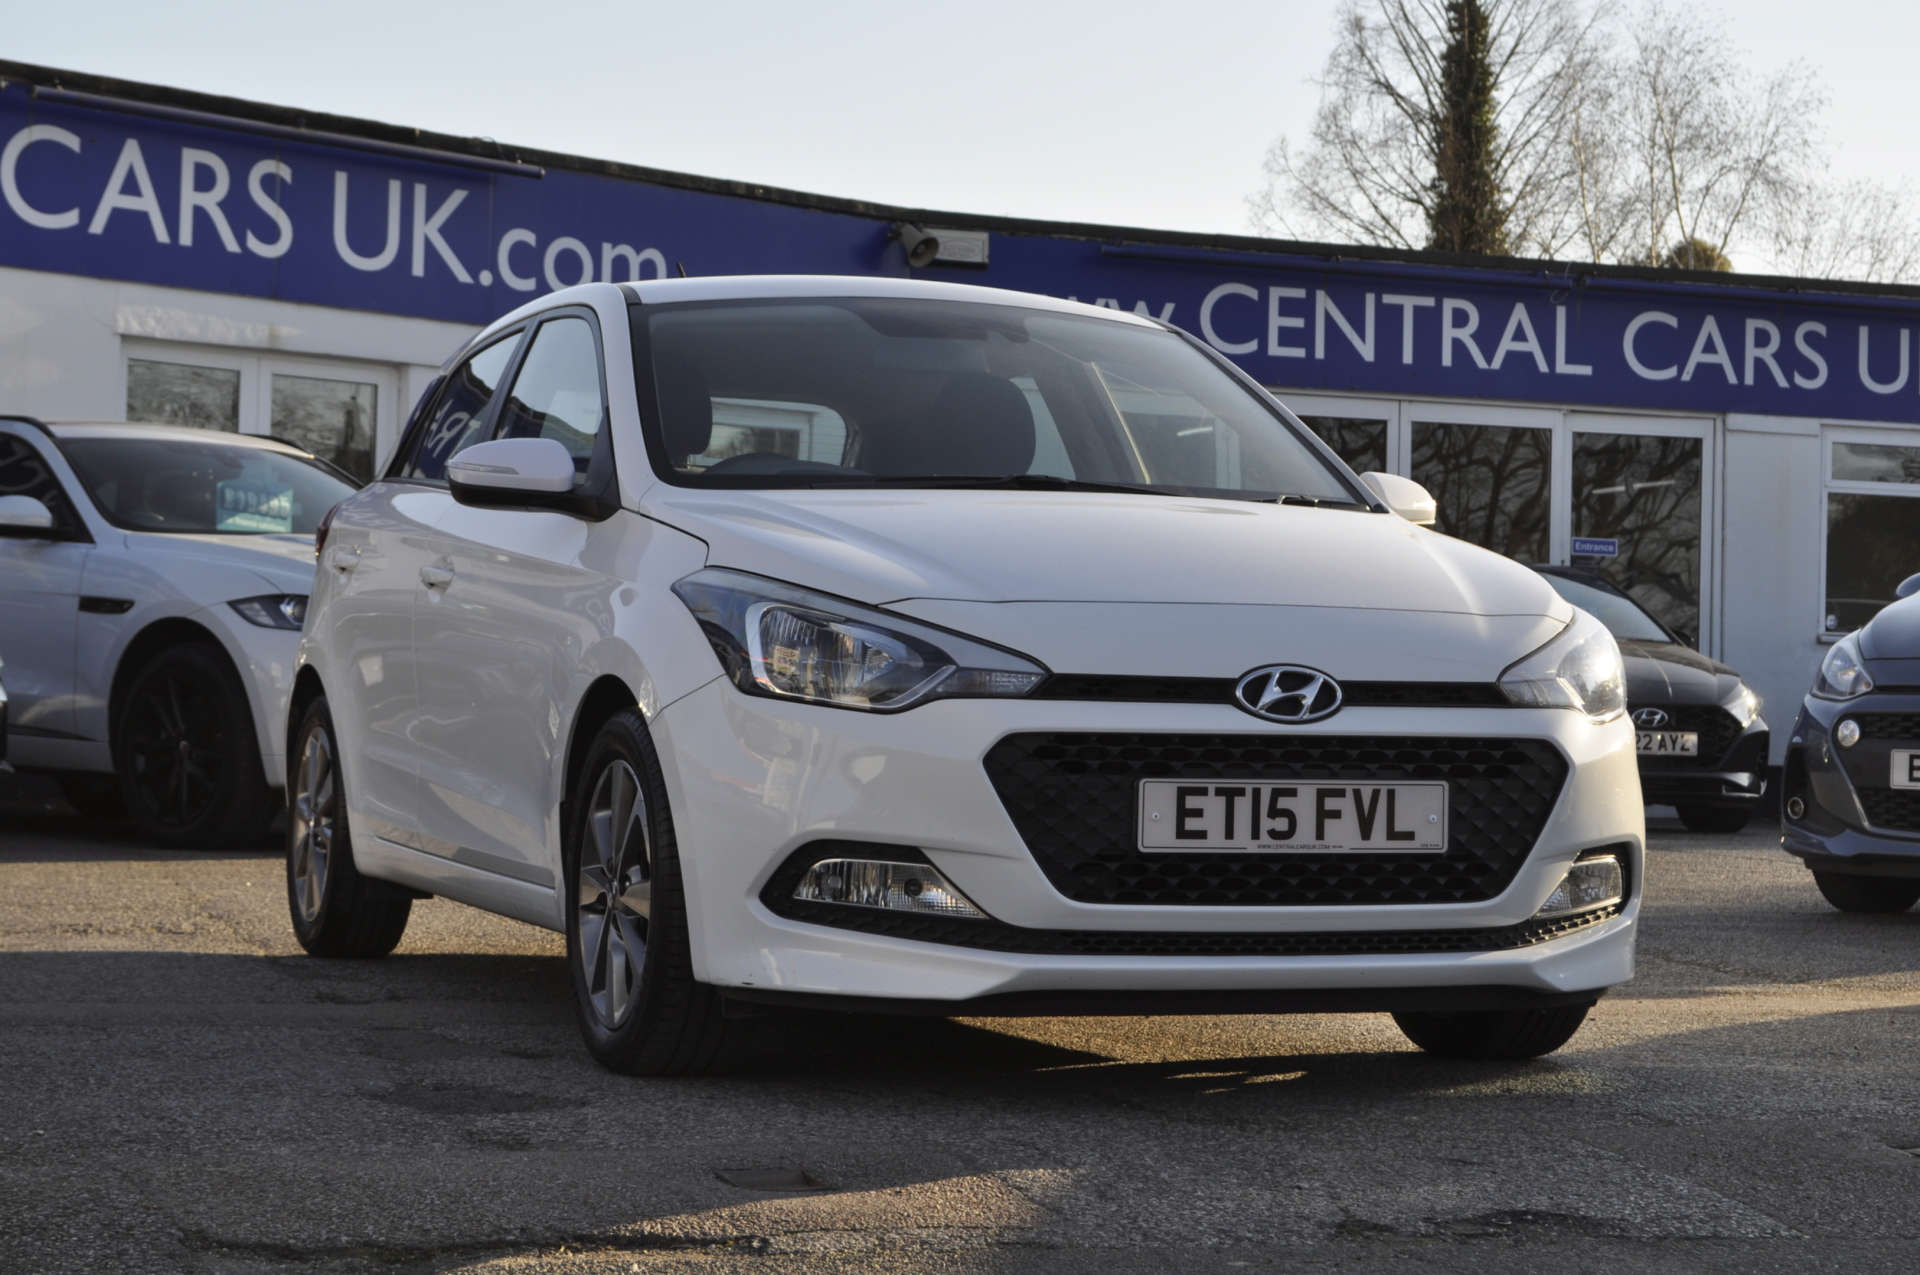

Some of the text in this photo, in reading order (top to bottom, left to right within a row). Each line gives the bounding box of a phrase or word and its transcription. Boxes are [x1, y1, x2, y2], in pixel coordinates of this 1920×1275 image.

[1, 124, 294, 259] CARS
[1199, 282, 1920, 395] CENTRAL CARS U
[1575, 541, 1615, 553] Entrance
[1315, 787, 1416, 841] FVL
